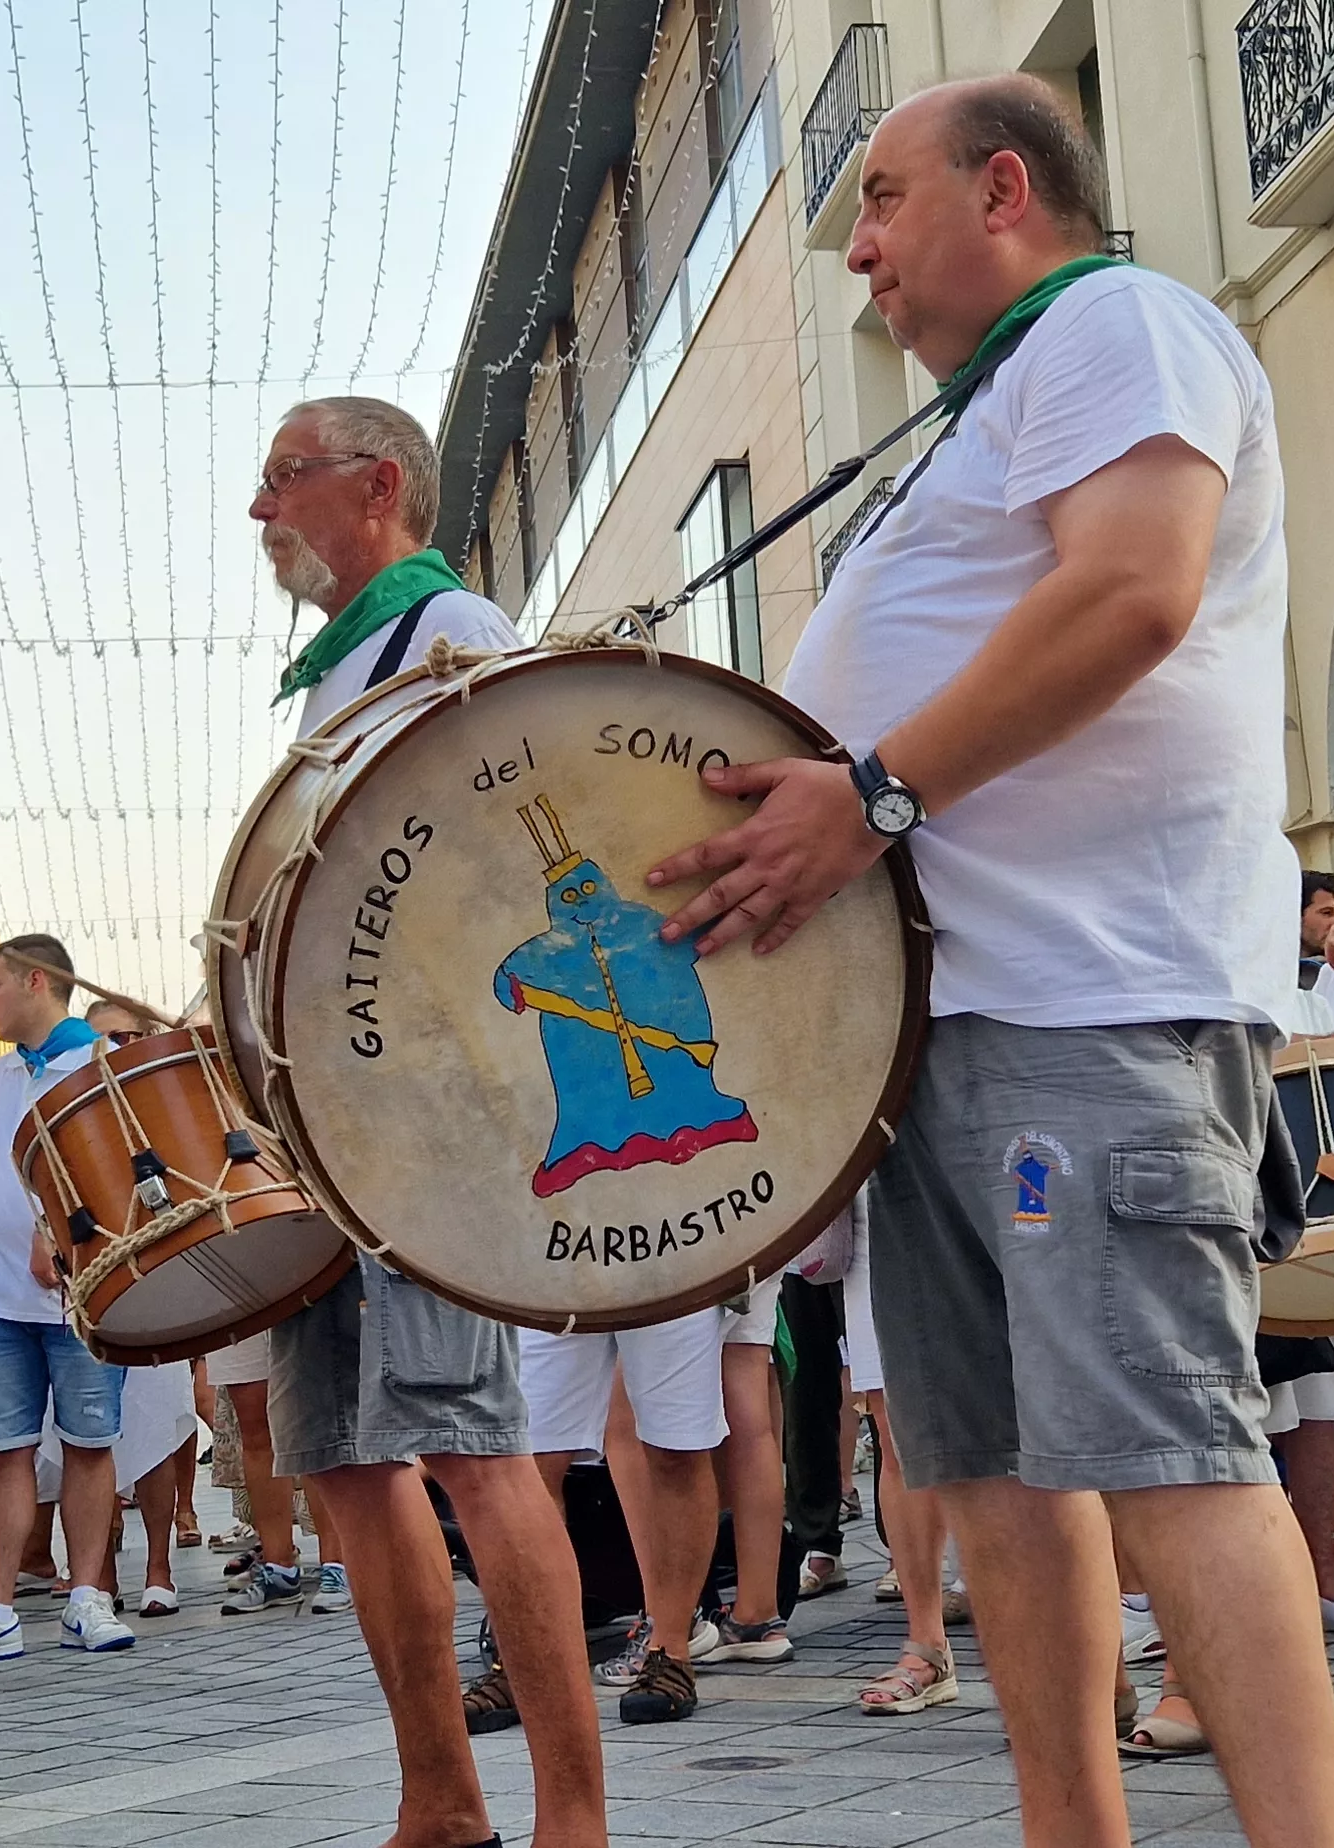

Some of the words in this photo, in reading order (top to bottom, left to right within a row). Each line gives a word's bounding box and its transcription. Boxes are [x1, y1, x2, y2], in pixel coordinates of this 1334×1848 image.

[346, 815, 434, 1058] GAITEROS
[473, 736, 535, 792] del
[594, 724, 731, 780] SOMO
[546, 1170, 774, 1267] BARBASTRO
